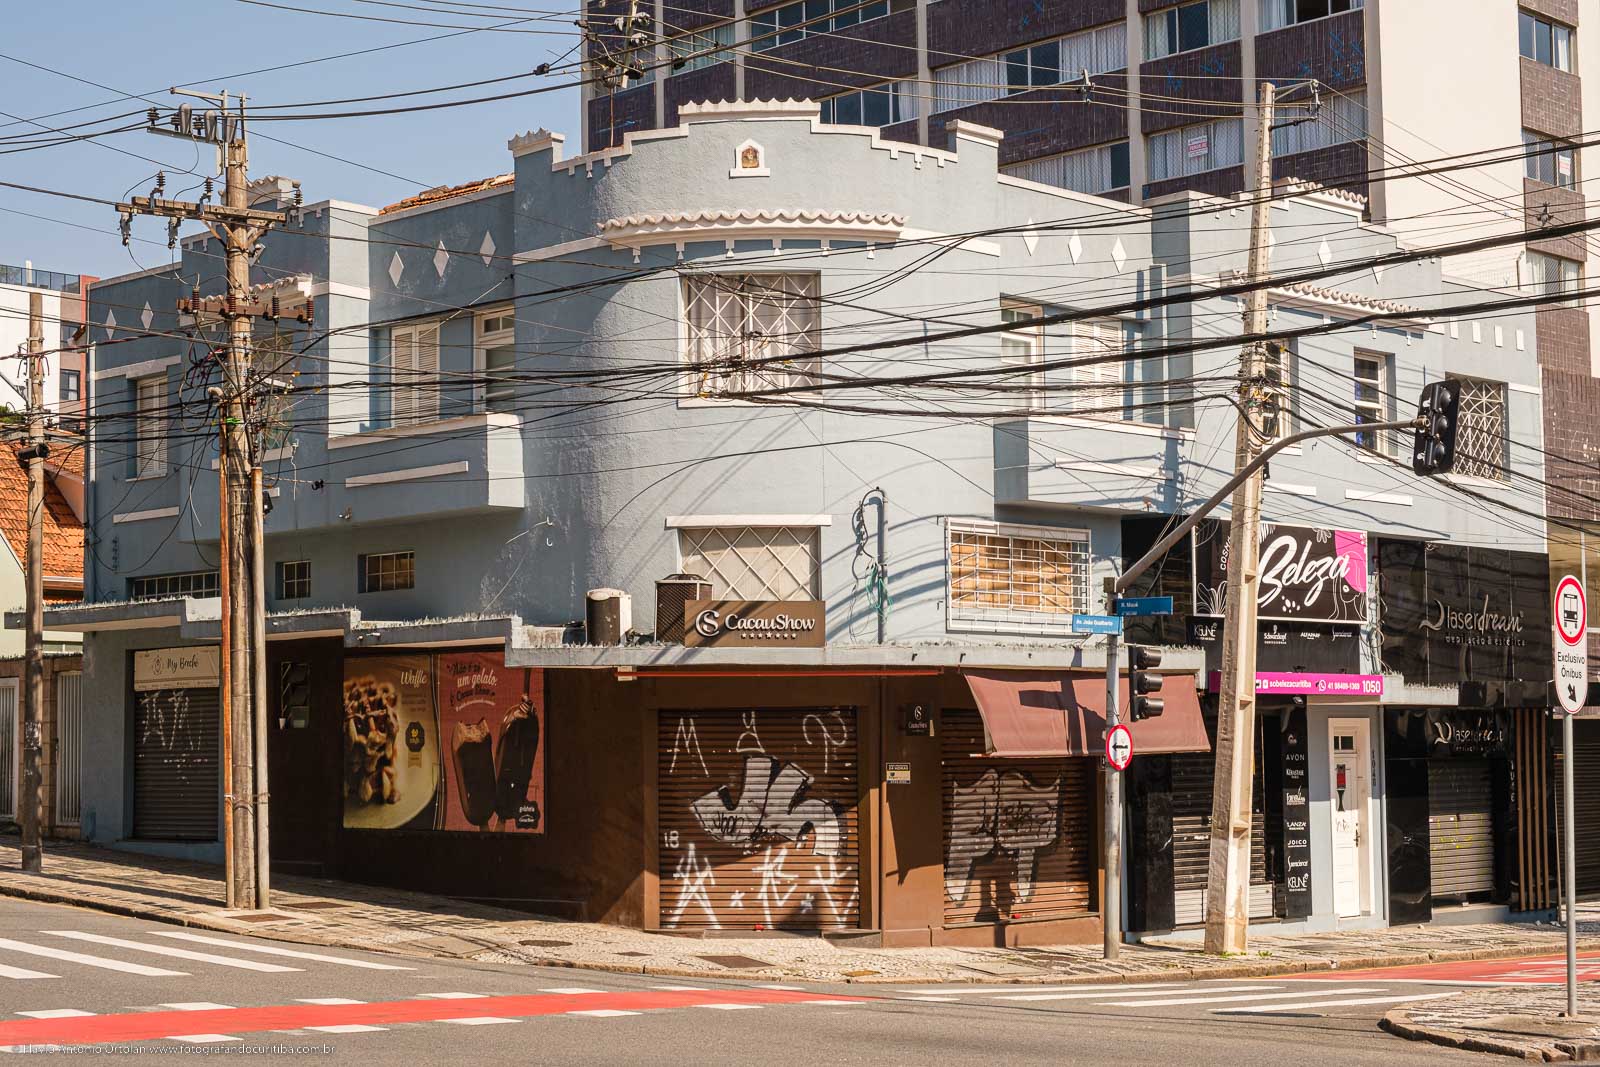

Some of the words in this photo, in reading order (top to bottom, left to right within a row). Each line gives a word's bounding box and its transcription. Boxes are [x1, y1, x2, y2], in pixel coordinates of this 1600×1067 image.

[1257, 535, 1350, 607] Beleza
[1447, 594, 1523, 635] laserdream
[1557, 651, 1585, 665] Exclusivo
[167, 657, 178, 674] My
[1561, 665, 1582, 679] Ônibus
[400, 668, 427, 688] Waffle
[457, 675, 470, 688] um
[1362, 680, 1381, 693] 1050
[1288, 876, 1308, 888] KEUNE
